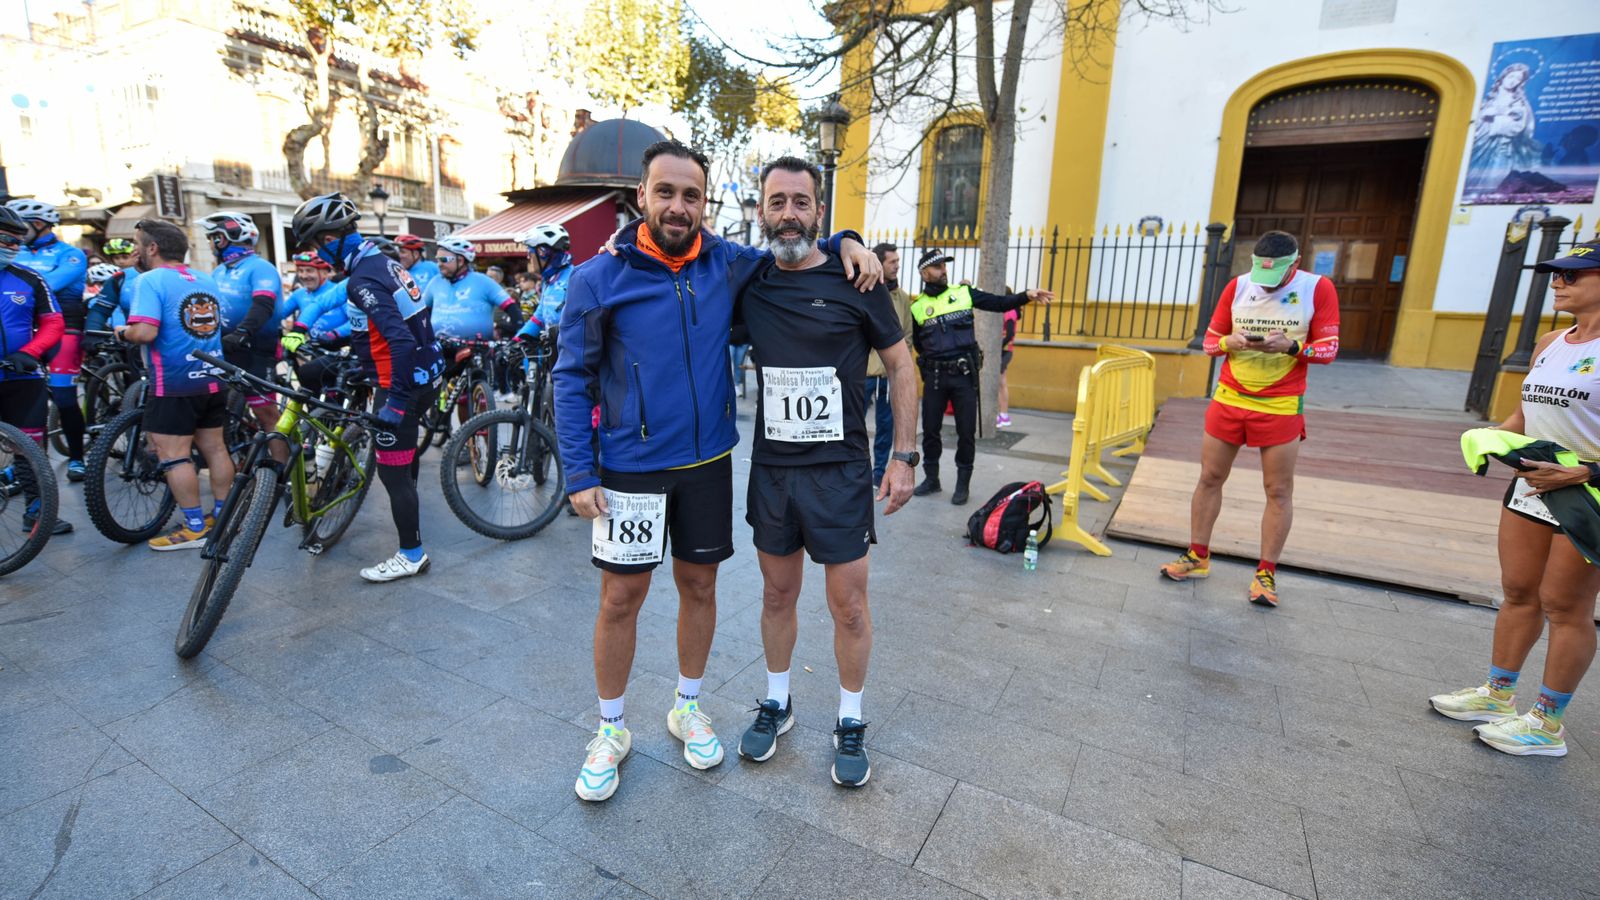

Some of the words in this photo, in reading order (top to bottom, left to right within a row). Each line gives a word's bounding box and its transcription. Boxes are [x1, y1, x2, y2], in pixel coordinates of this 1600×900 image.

[1241, 325, 1288, 333] ALGECIS
[1257, 318, 1300, 326] TRIATLÓN
[1533, 384, 1591, 401] TRIATLÓN
[781, 395, 830, 421] 102
[607, 518, 653, 544] 188
